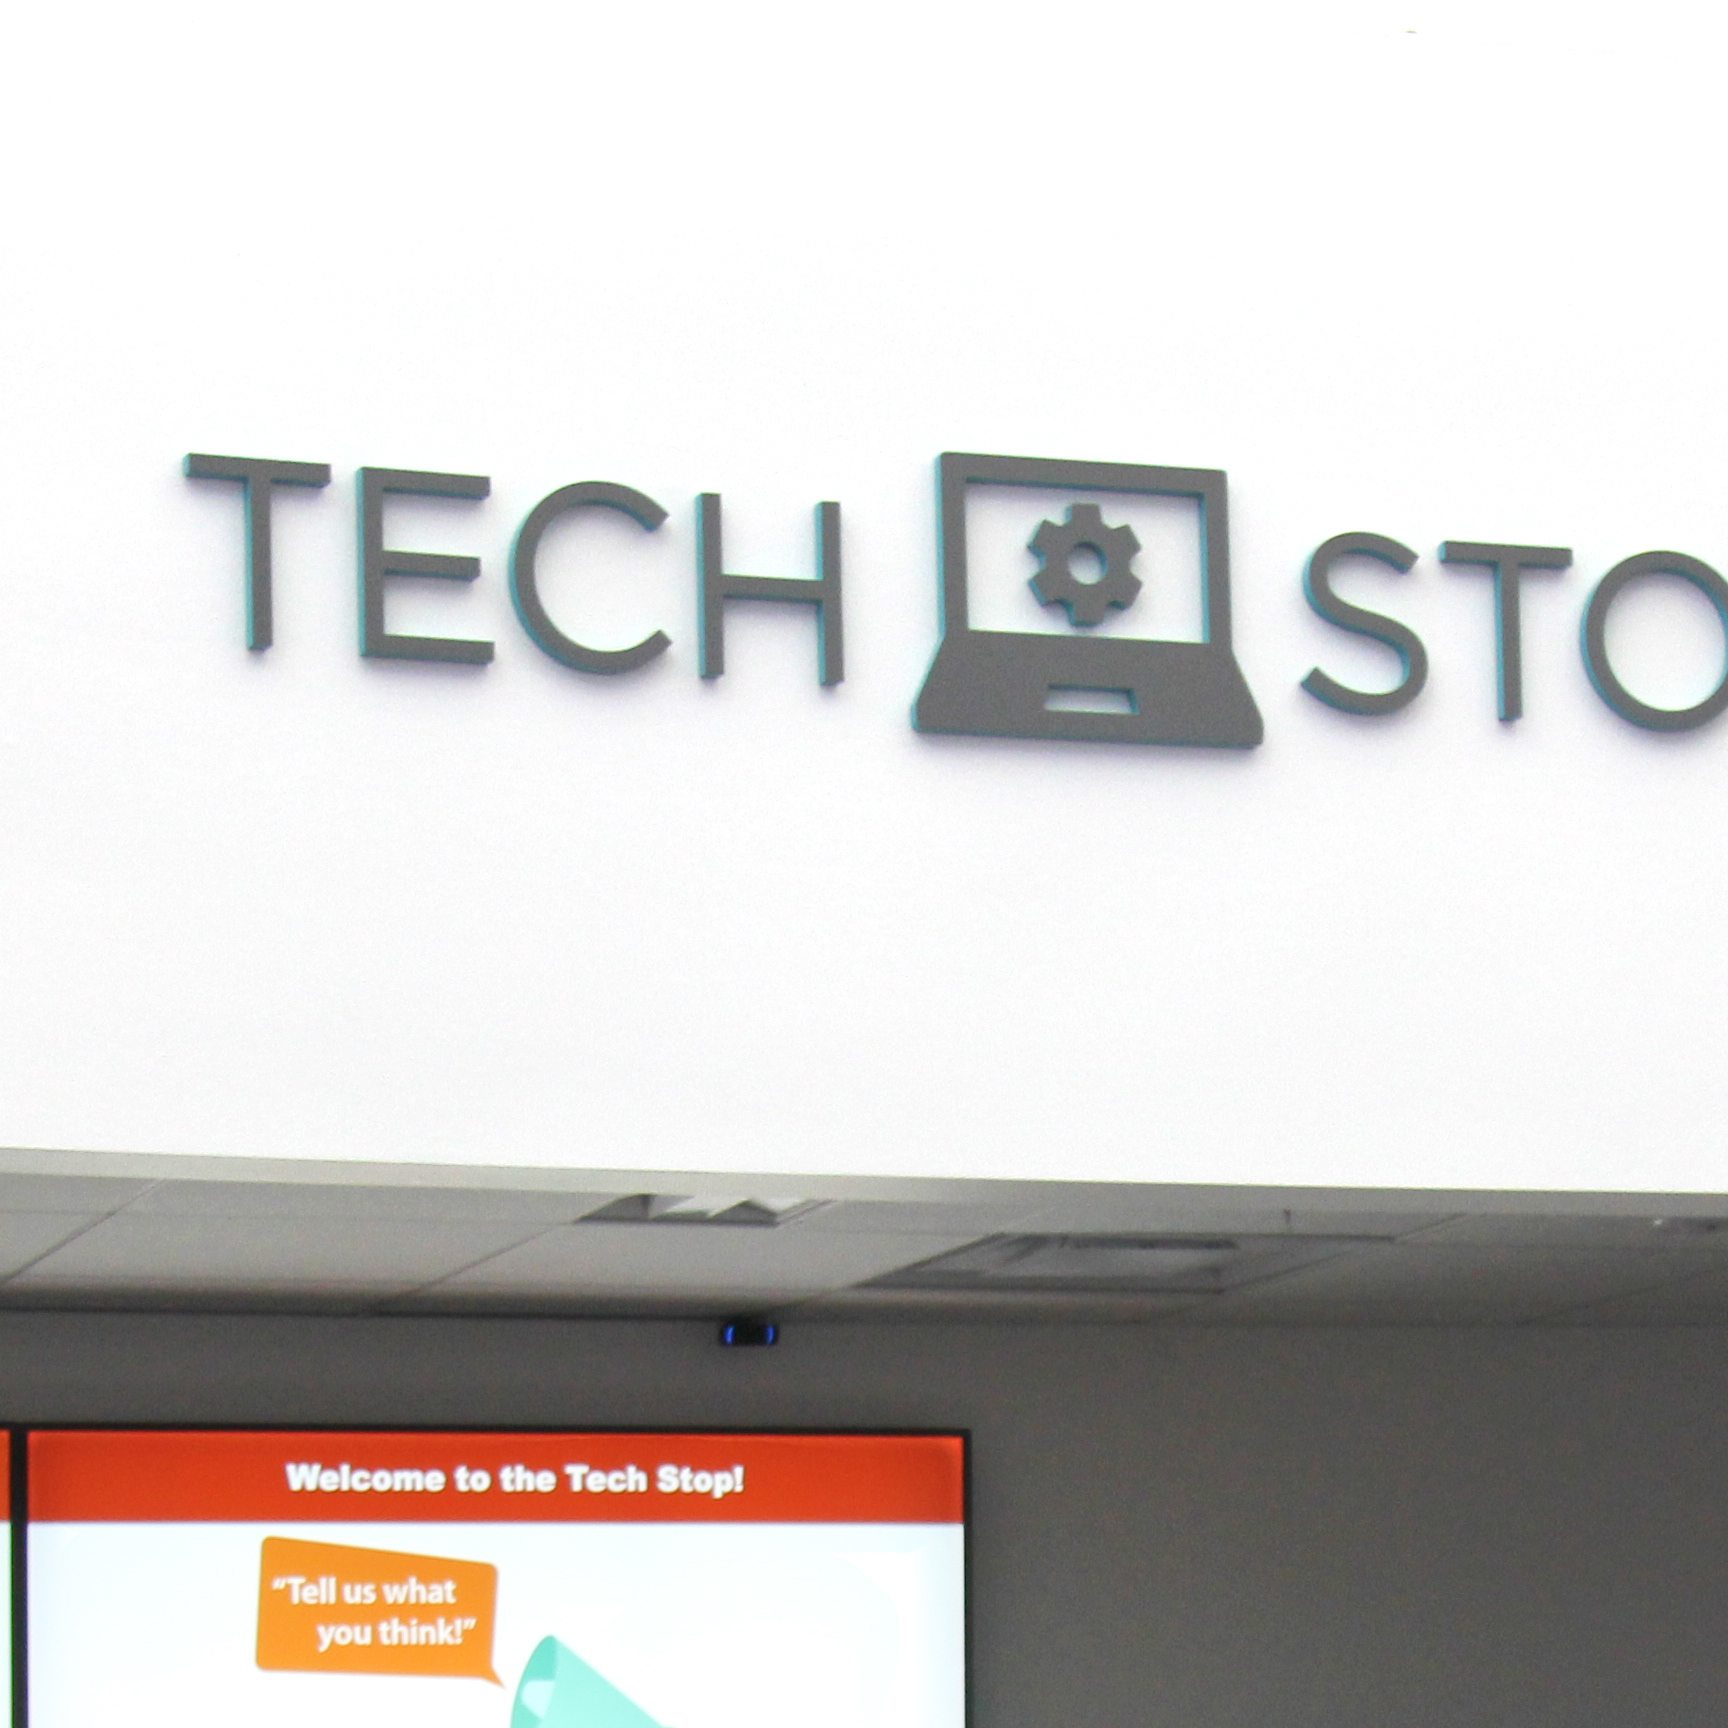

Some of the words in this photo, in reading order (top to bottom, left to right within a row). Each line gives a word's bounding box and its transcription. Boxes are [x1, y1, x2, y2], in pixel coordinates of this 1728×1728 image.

[182, 452, 845, 693] TECH
[285, 1462, 446, 1492] Welcome
[453, 1465, 491, 1492] to
[498, 1464, 557, 1493] the
[564, 1463, 648, 1493] Tech
[656, 1464, 745, 1499] Stop!
[343, 1583, 377, 1604] us
[383, 1577, 456, 1604] what
[317, 1623, 373, 1652] you
